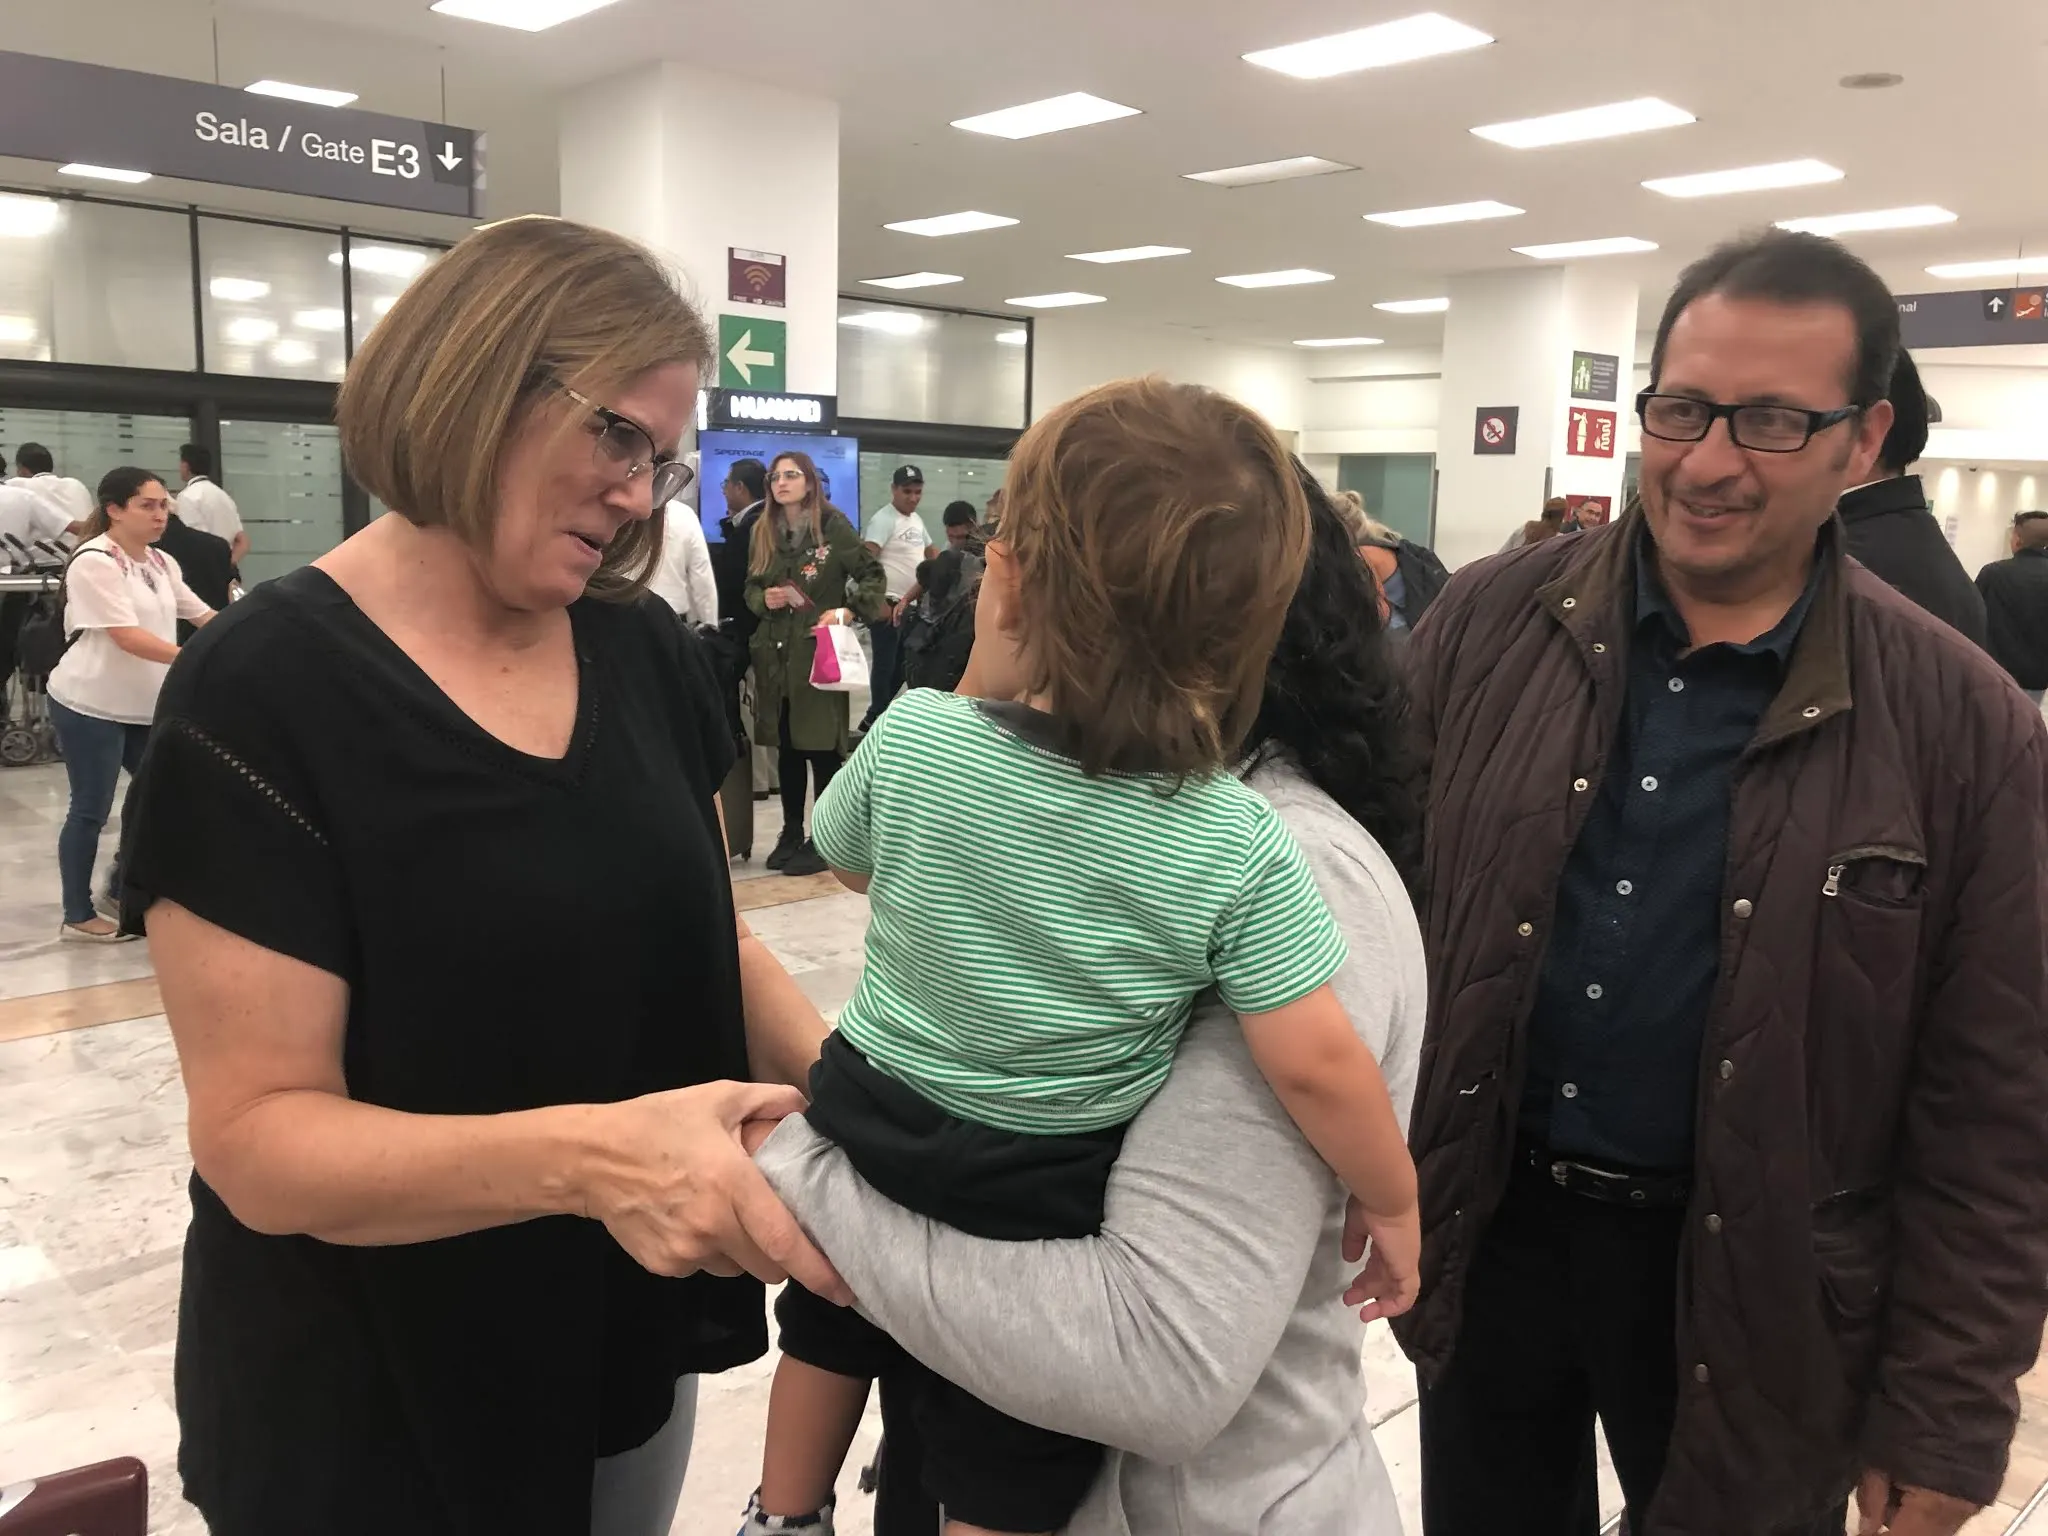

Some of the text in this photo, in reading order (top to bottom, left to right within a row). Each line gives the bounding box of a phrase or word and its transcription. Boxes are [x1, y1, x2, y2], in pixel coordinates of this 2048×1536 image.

[195, 111, 421, 179] Sala / Gate E3
[714, 447, 766, 457] SPORTAGE
